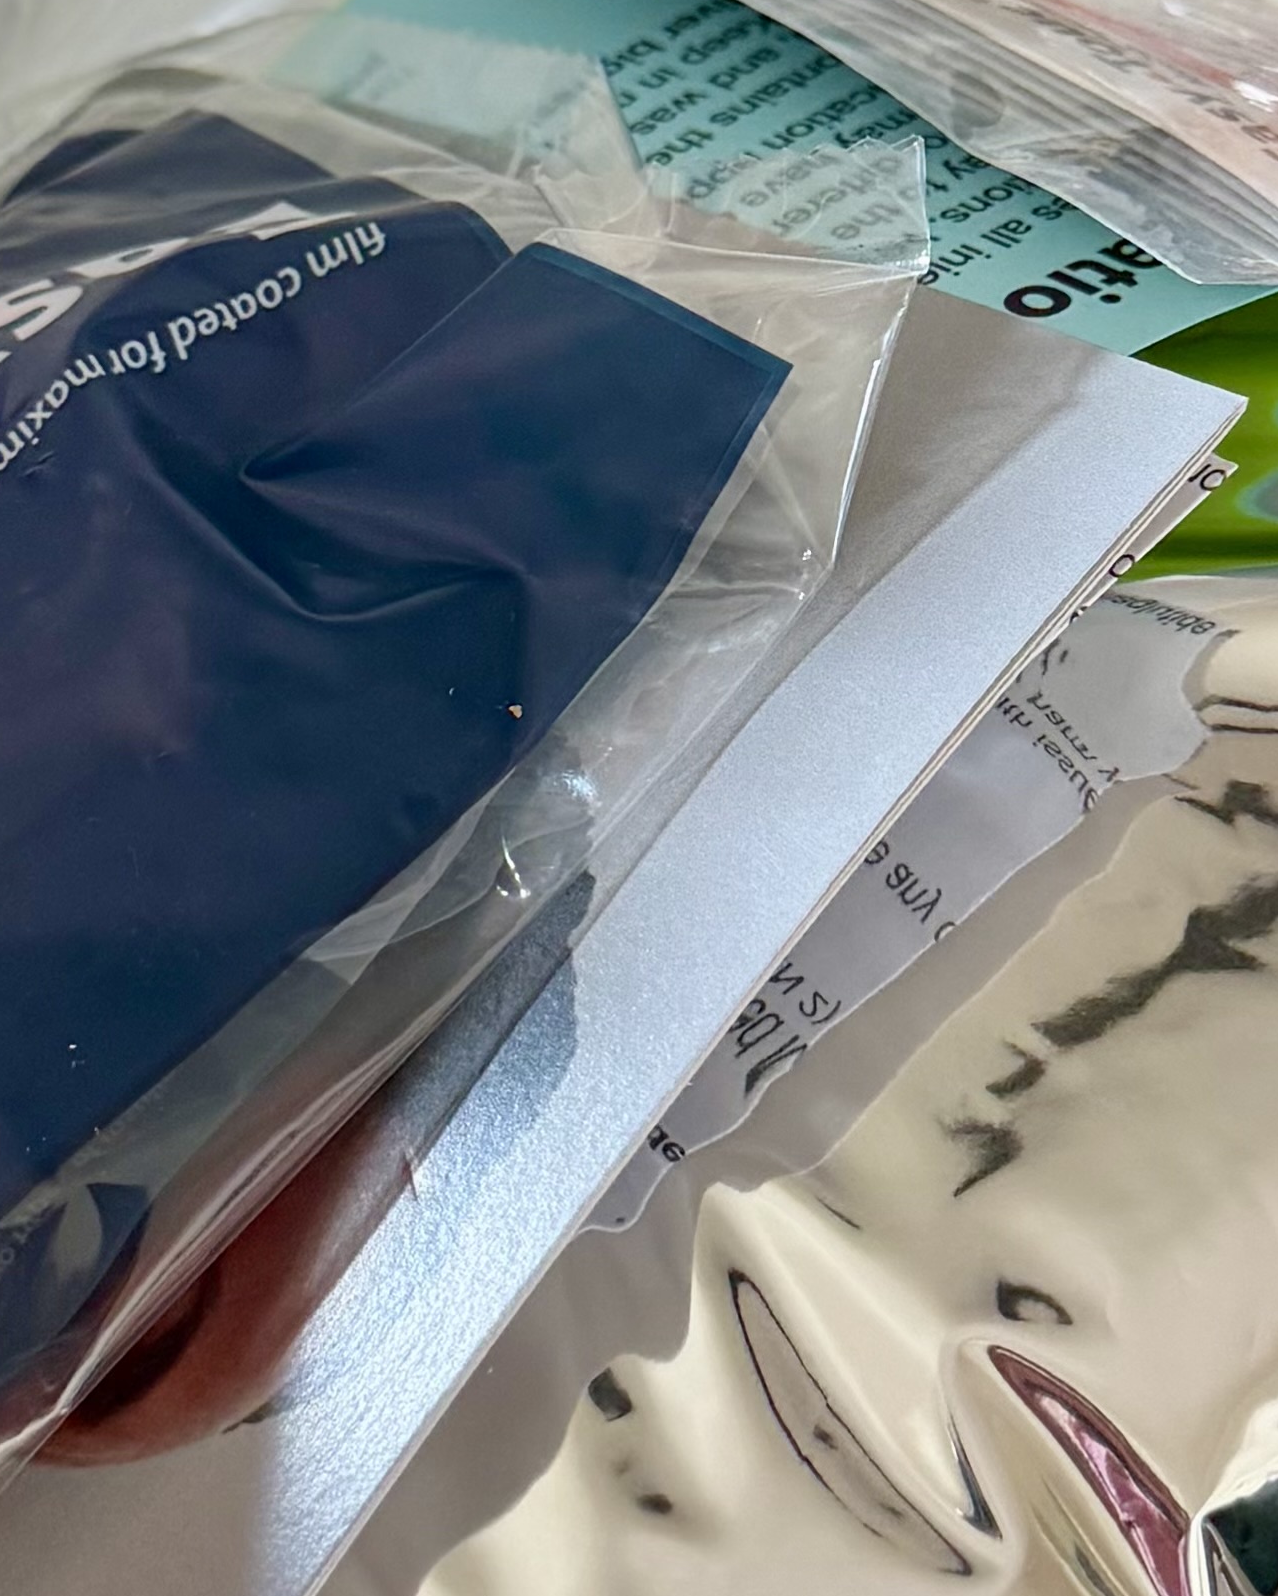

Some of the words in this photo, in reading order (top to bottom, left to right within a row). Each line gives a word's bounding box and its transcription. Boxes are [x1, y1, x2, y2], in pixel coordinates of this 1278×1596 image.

[305, 221, 387, 278] film
[981, 217, 1033, 250] all
[167, 266, 302, 361] coated
[108, 330, 167, 374] for
